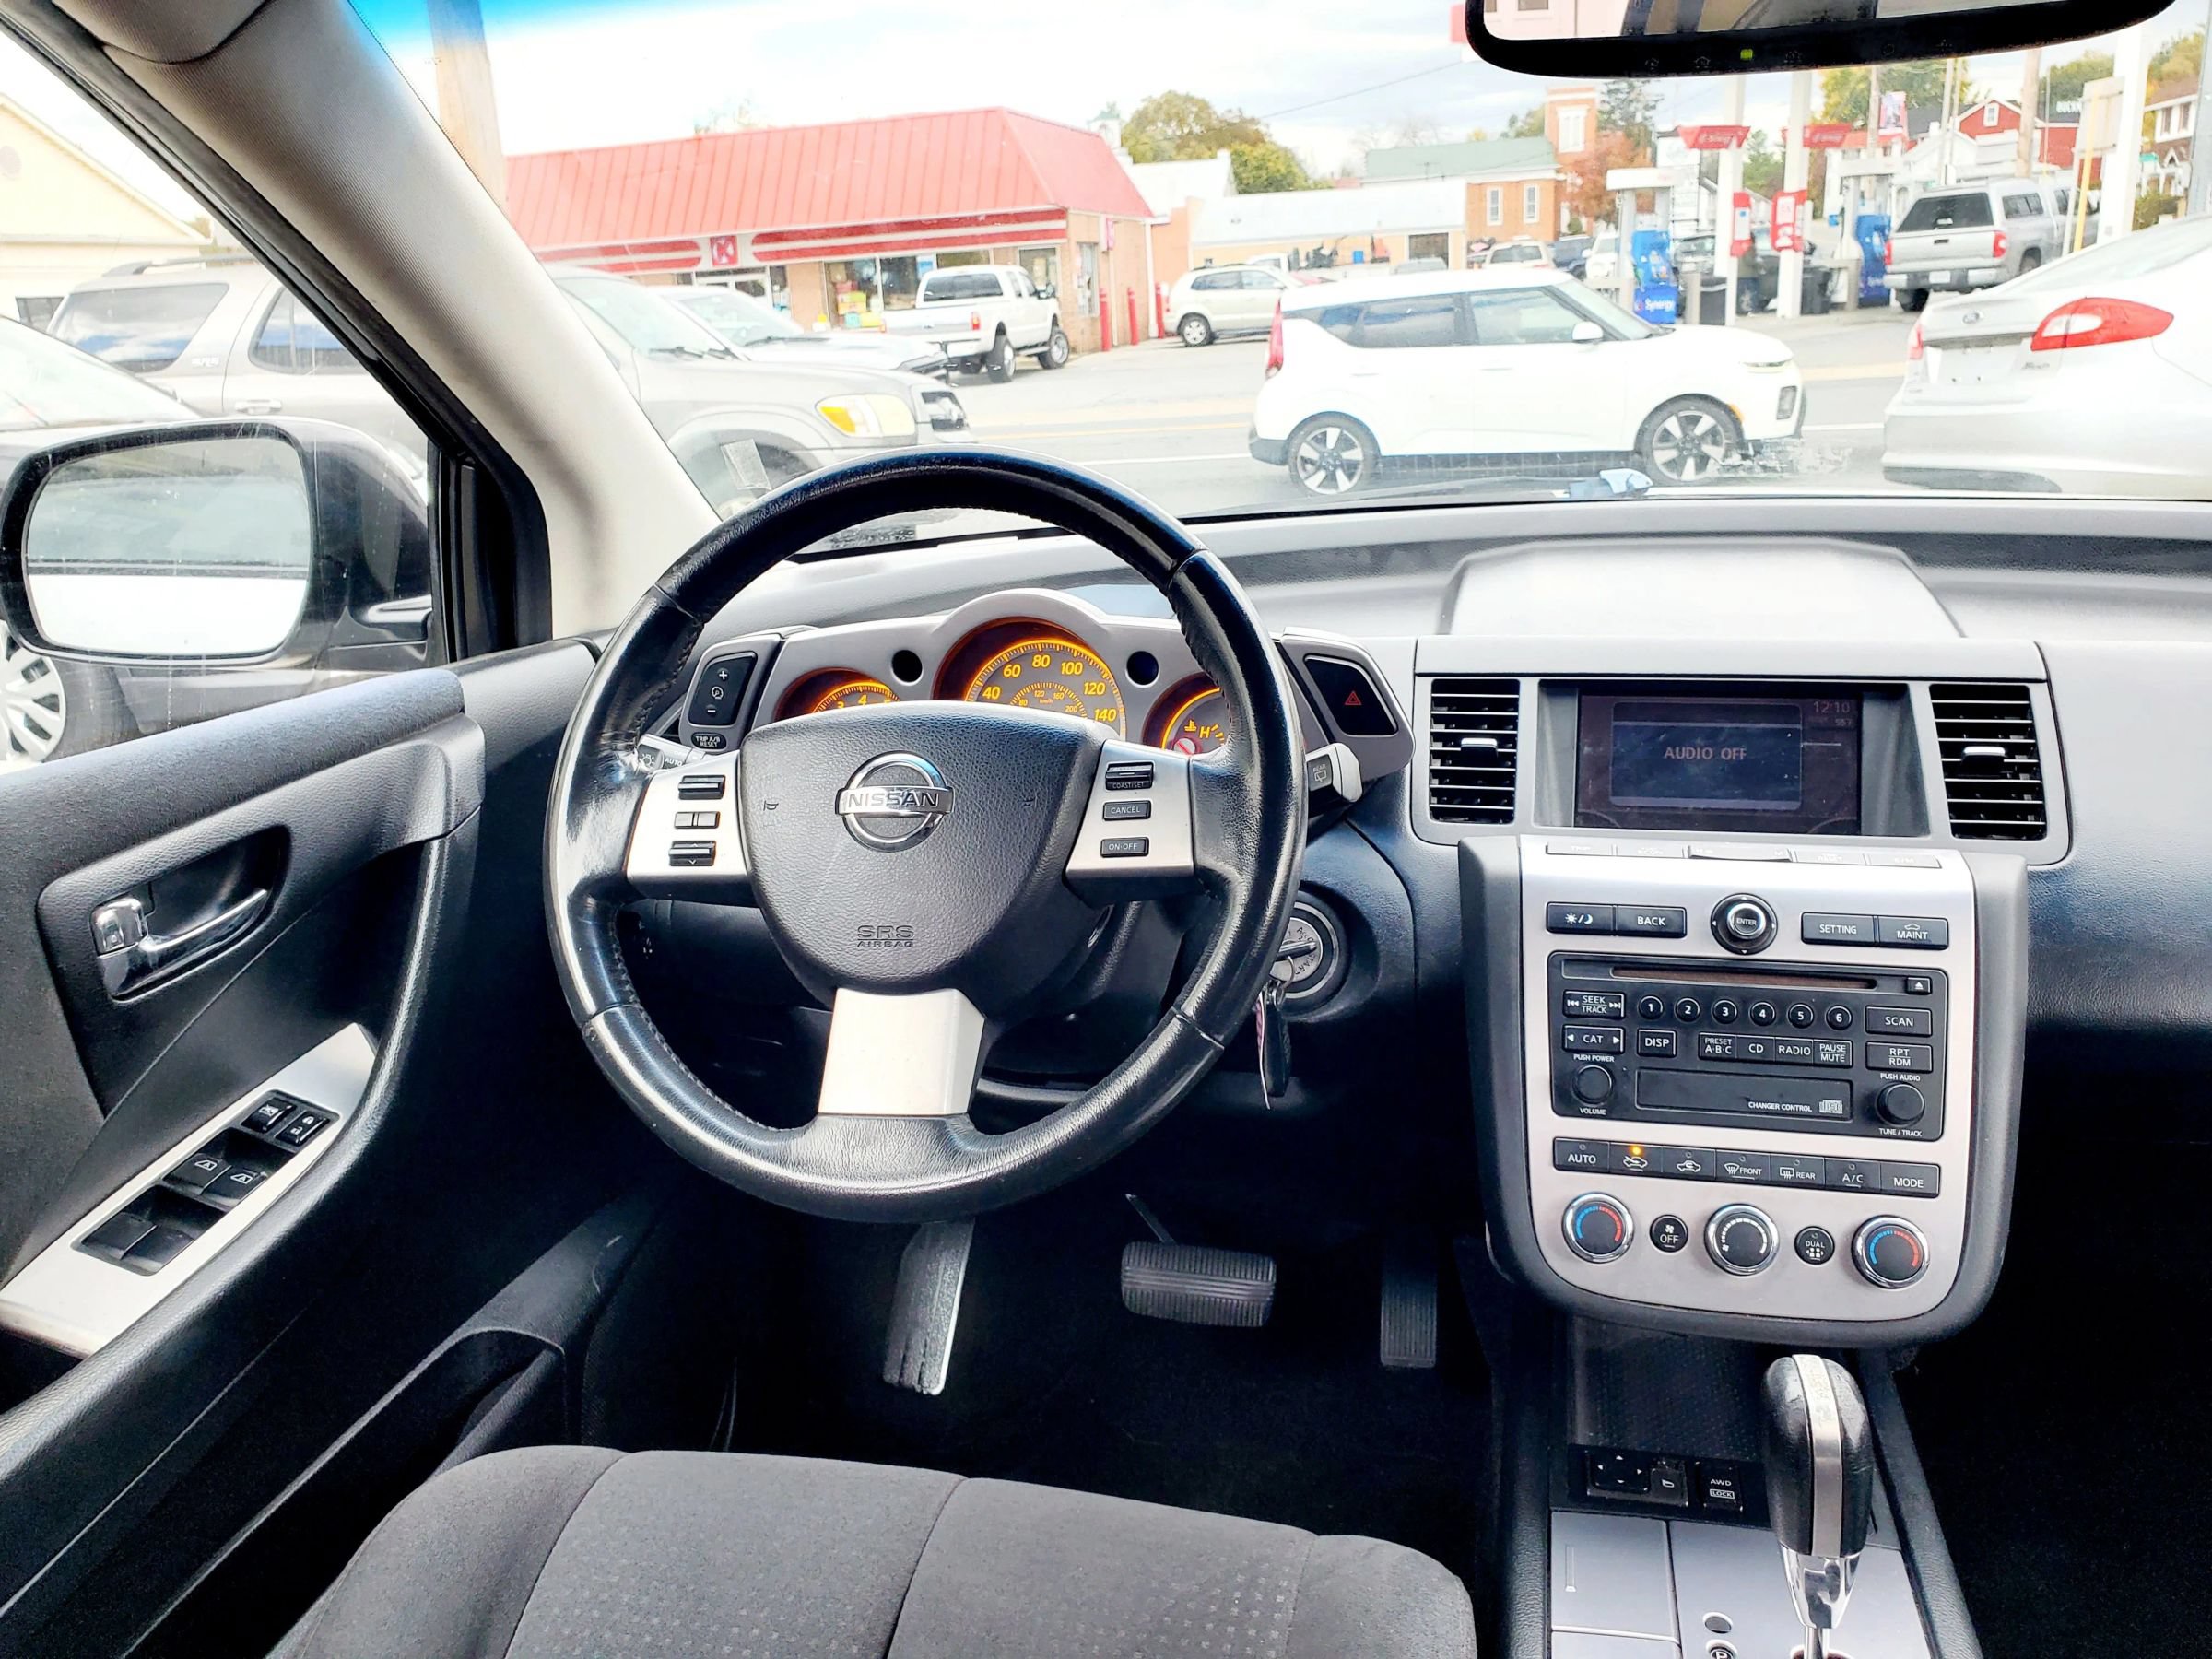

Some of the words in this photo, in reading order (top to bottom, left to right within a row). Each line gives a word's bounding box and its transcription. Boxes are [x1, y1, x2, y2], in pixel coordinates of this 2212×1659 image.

[1031, 654, 1051, 667] 80
[1003, 664, 1021, 677] 60
[1061, 662, 1083, 675] 100
[982, 686, 1001, 700] 40
[1084, 682, 1106, 695] 120
[858, 694, 867, 706] 4
[1094, 708, 1117, 722] 140
[1199, 725, 1211, 738] H
[1664, 747, 1713, 760] AUDIO
[1720, 748, 1747, 760] OFF
[665, 758, 683, 766] AUTO
[847, 792, 940, 808] NISSAN
[1110, 806, 1141, 814] CANCEL
[1637, 915, 1666, 926] BACK
[1735, 917, 1758, 926] ENTER
[857, 924, 914, 939] SRS
[1819, 924, 1857, 935] SETTING
[1897, 930, 1928, 940] MAINT
[856, 940, 913, 948] AIRBAG
[1583, 995, 1606, 1004] SEEK
[1582, 1005, 1607, 1014] TRACK
[1648, 1003, 1653, 1012] 1
[1685, 1005, 1692, 1015] 2
[1722, 1006, 1729, 1017] 3
[1759, 1008, 1766, 1018] 4
[1797, 1010, 1805, 1020] 5
[1835, 1012, 1843, 1023] 6
[1885, 1016, 1914, 1027] SCAN
[1583, 1034, 1604, 1044] CAT
[1644, 1038, 1670, 1048] DISP
[1704, 1037, 1733, 1045] PRESET
[1748, 1043, 1764, 1053] CD
[1778, 1045, 1811, 1056] RADIO
[1819, 1043, 1846, 1053] PAUSE
[1889, 1048, 1910, 1057] RPT
[1820, 1053, 1845, 1063] MUTE
[1888, 1057, 1911, 1067] RDM
[1900, 1074, 1921, 1082] AUDIO
[1578, 1107, 1606, 1115] VOLUME
[1747, 1101, 1780, 1111] CHANGER
[1781, 1103, 1813, 1112] CONTROL
[1901, 1129, 1923, 1137] TRACK
[1567, 1153, 1596, 1164] AUTO
[1739, 1167, 1762, 1176] FRONT
[1842, 1173, 1864, 1183] A/C
[1893, 1177, 1924, 1188] MODE
[1660, 1234, 1679, 1243] OFF
[1805, 1240, 1826, 1249] DUAL
[1710, 1478, 1732, 1487] AWD
